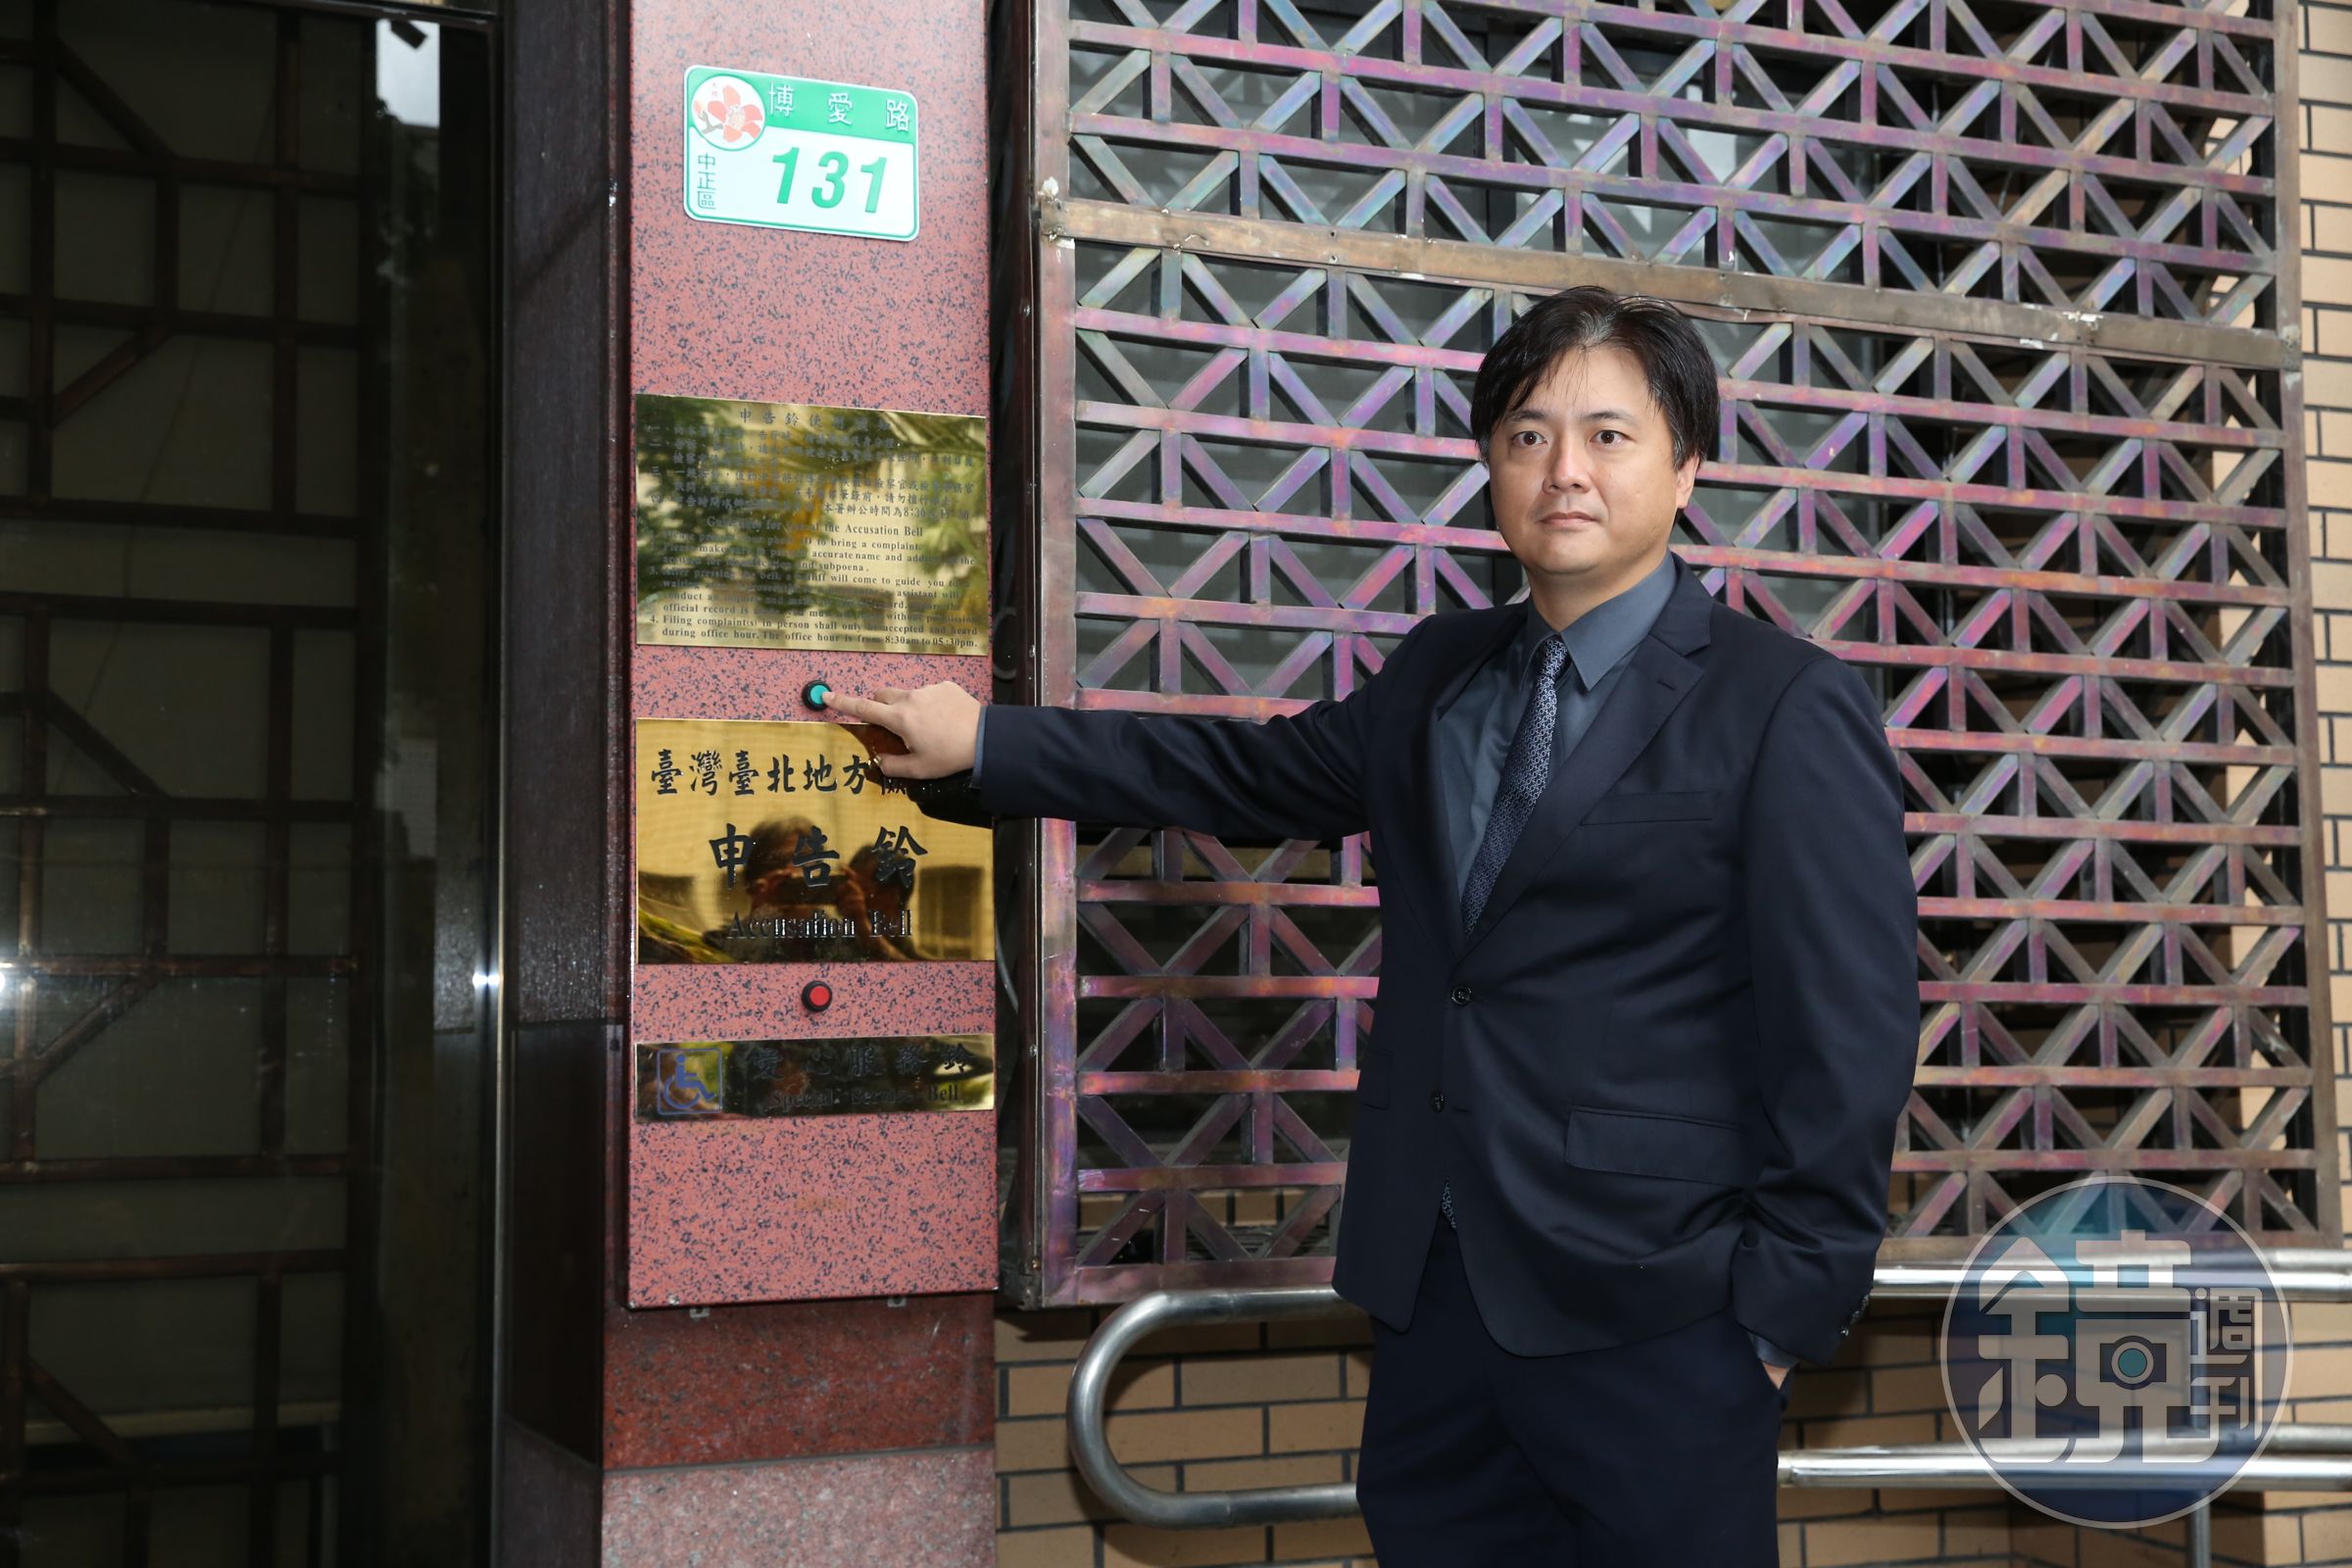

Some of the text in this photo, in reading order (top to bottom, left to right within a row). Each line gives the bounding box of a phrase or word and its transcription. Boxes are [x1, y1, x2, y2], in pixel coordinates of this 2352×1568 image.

[768, 81, 910, 132] 博愛路
[697, 153, 716, 210] 中正區
[772, 146, 888, 214] 131
[846, 523, 900, 536] Accusation
[905, 525, 924, 537] Bell
[699, 544, 729, 554] make
[812, 550, 854, 559] accurate
[885, 553, 903, 562] and
[831, 538, 858, 549] bring
[895, 577, 921, 586] guide
[662, 603, 699, 612] official
[704, 605, 736, 613] record
[740, 606, 750, 614] is
[650, 614, 659, 623] 4.
[662, 614, 692, 626] Filing
[697, 616, 758, 627] complaint(s)
[762, 618, 772, 627] in
[777, 620, 809, 630] person
[842, 622, 862, 633] only
[884, 625, 924, 635] accepted
[662, 627, 696, 638] during
[701, 628, 729, 638] office
[733, 630, 760, 639] hour.
[763, 630, 780, 640] The
[785, 631, 812, 641] office
[817, 632, 840, 642] hour
[844, 633, 853, 642] is
[858, 634, 880, 643] from
[885, 635, 919, 645] 8:30am
[651, 749, 906, 796] 臺灣臺北地方
[709, 823, 928, 890] 申告鈴
[727, 909, 912, 939] Accusation Bell
